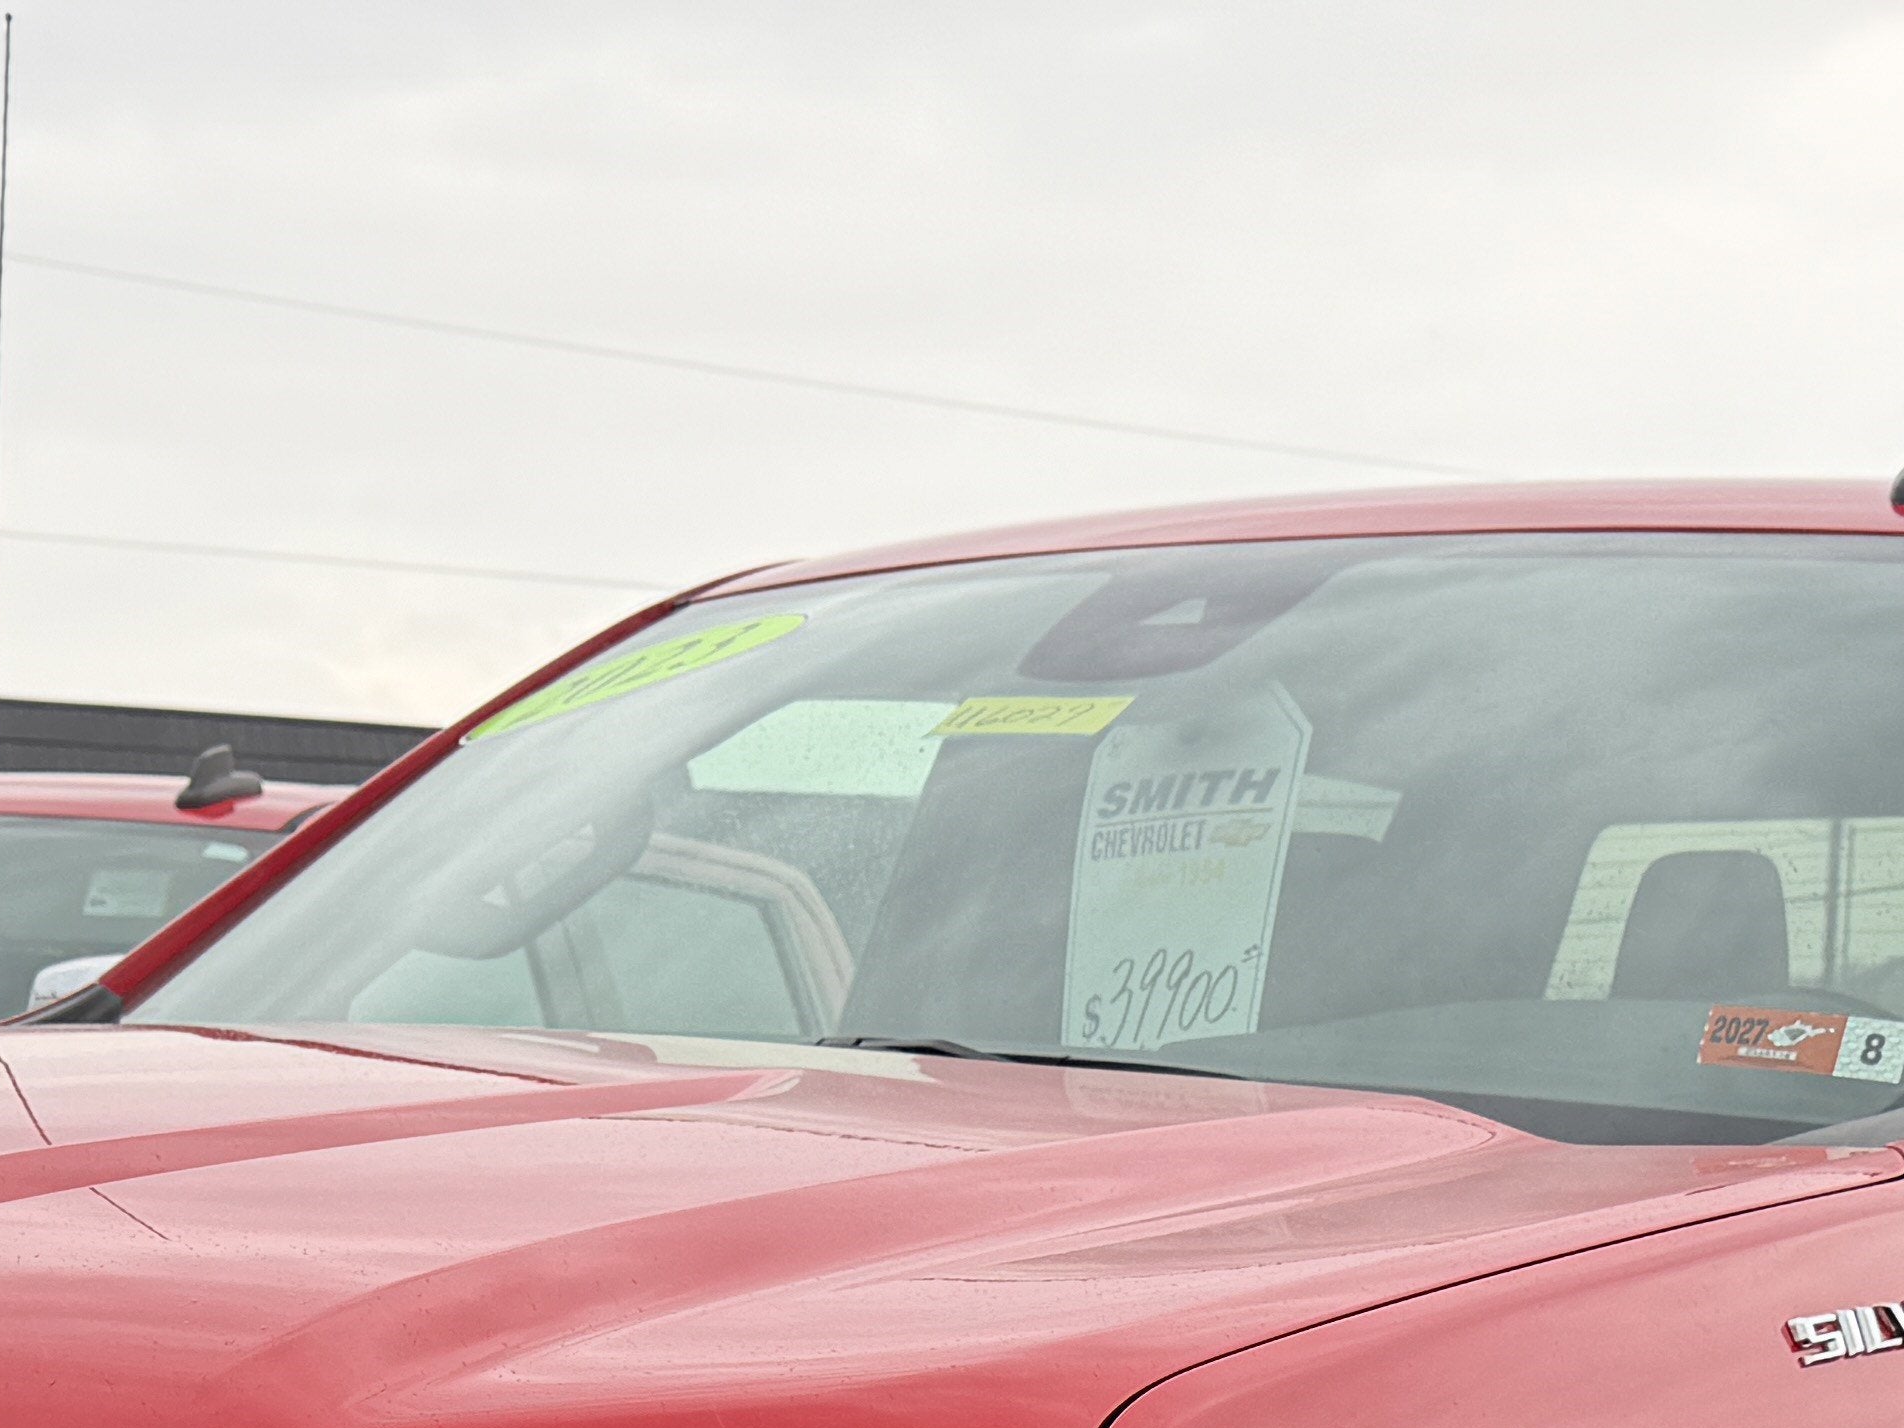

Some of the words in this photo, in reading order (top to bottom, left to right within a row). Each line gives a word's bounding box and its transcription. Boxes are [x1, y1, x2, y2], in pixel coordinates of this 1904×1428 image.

[1097, 767, 1281, 819] SMITH
[1091, 819, 1207, 862] CHEVROLET
[1710, 1015, 1770, 1045] 2027
[1859, 1032, 1887, 1066] 8
